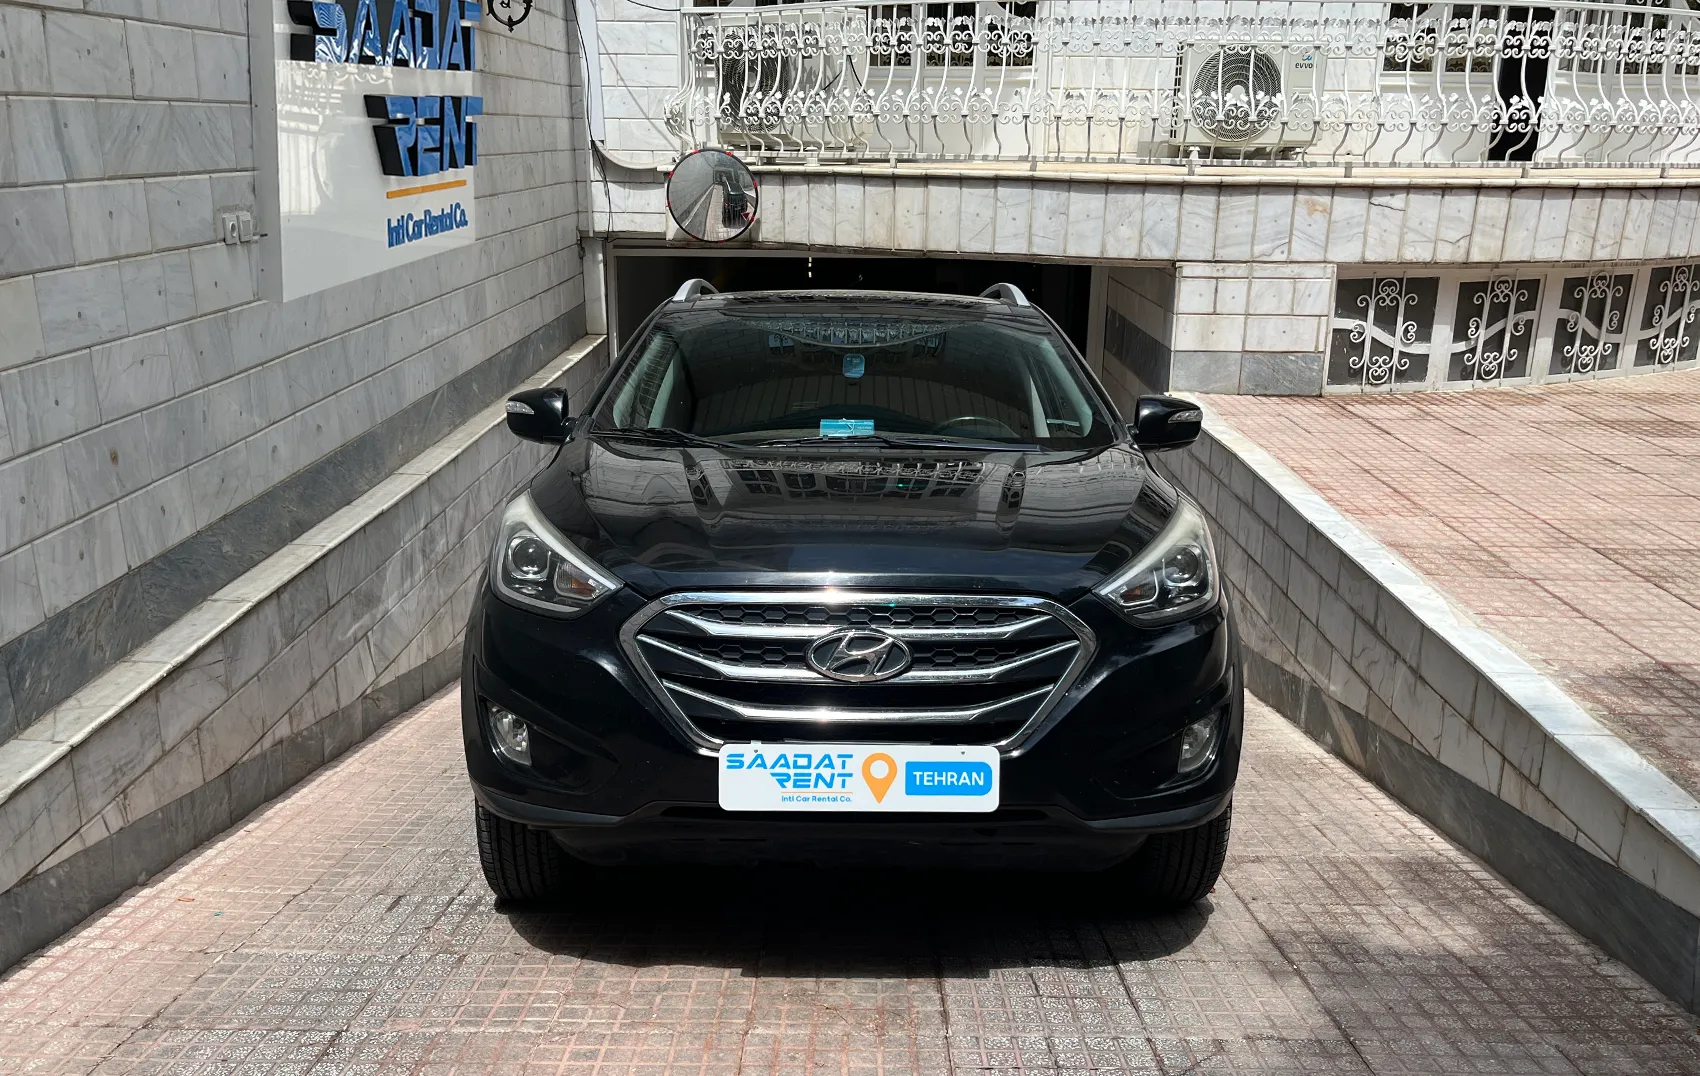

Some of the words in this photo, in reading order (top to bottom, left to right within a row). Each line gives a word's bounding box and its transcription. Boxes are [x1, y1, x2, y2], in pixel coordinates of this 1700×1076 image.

[374, 95, 483, 177] RENT
[406, 212, 424, 242] Car
[424, 203, 454, 237] Rental
[454, 202, 469, 229] Co.
[726, 753, 853, 770] SAADAT
[769, 772, 853, 789] RENT
[912, 771, 985, 786] TEHRAN
[796, 795, 810, 803] Car
[811, 795, 839, 803] Rental
[840, 795, 853, 803] Co.
